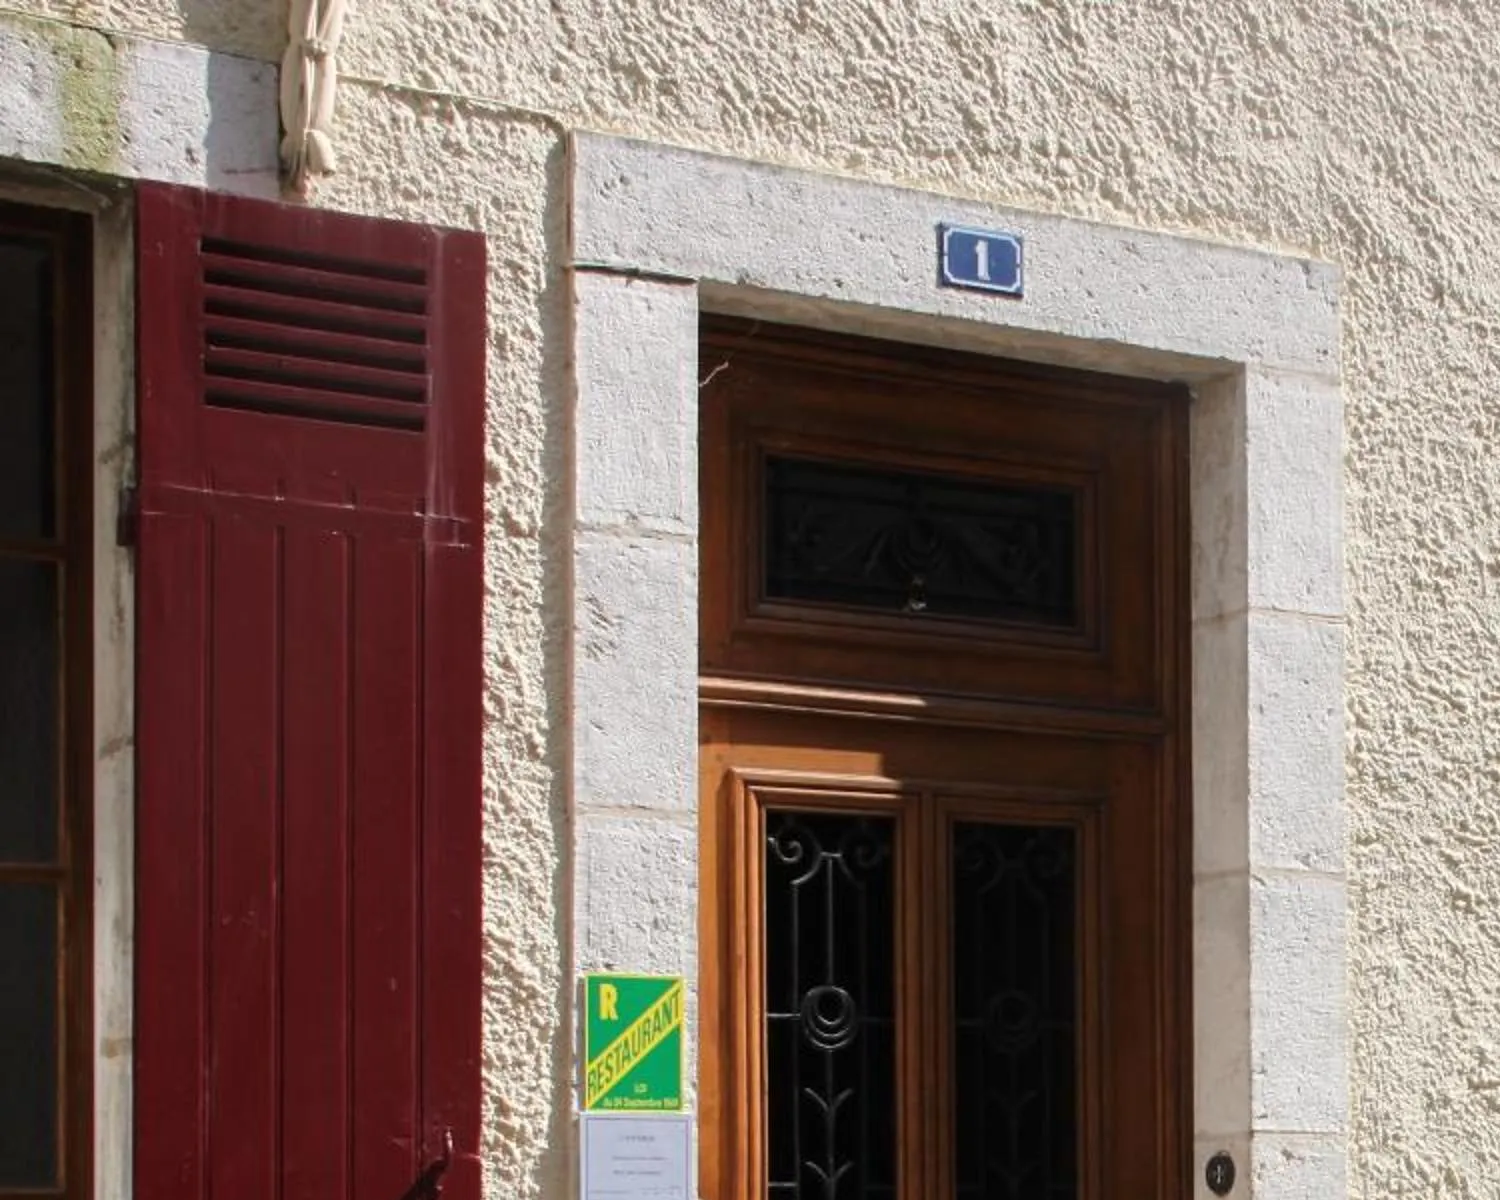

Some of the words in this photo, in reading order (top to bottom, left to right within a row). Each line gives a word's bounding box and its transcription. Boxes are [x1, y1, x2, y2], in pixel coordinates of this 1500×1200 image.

[975, 240, 990, 281] 1
[599, 983, 618, 1020] R
[588, 990, 680, 1098] RESTAURANT
